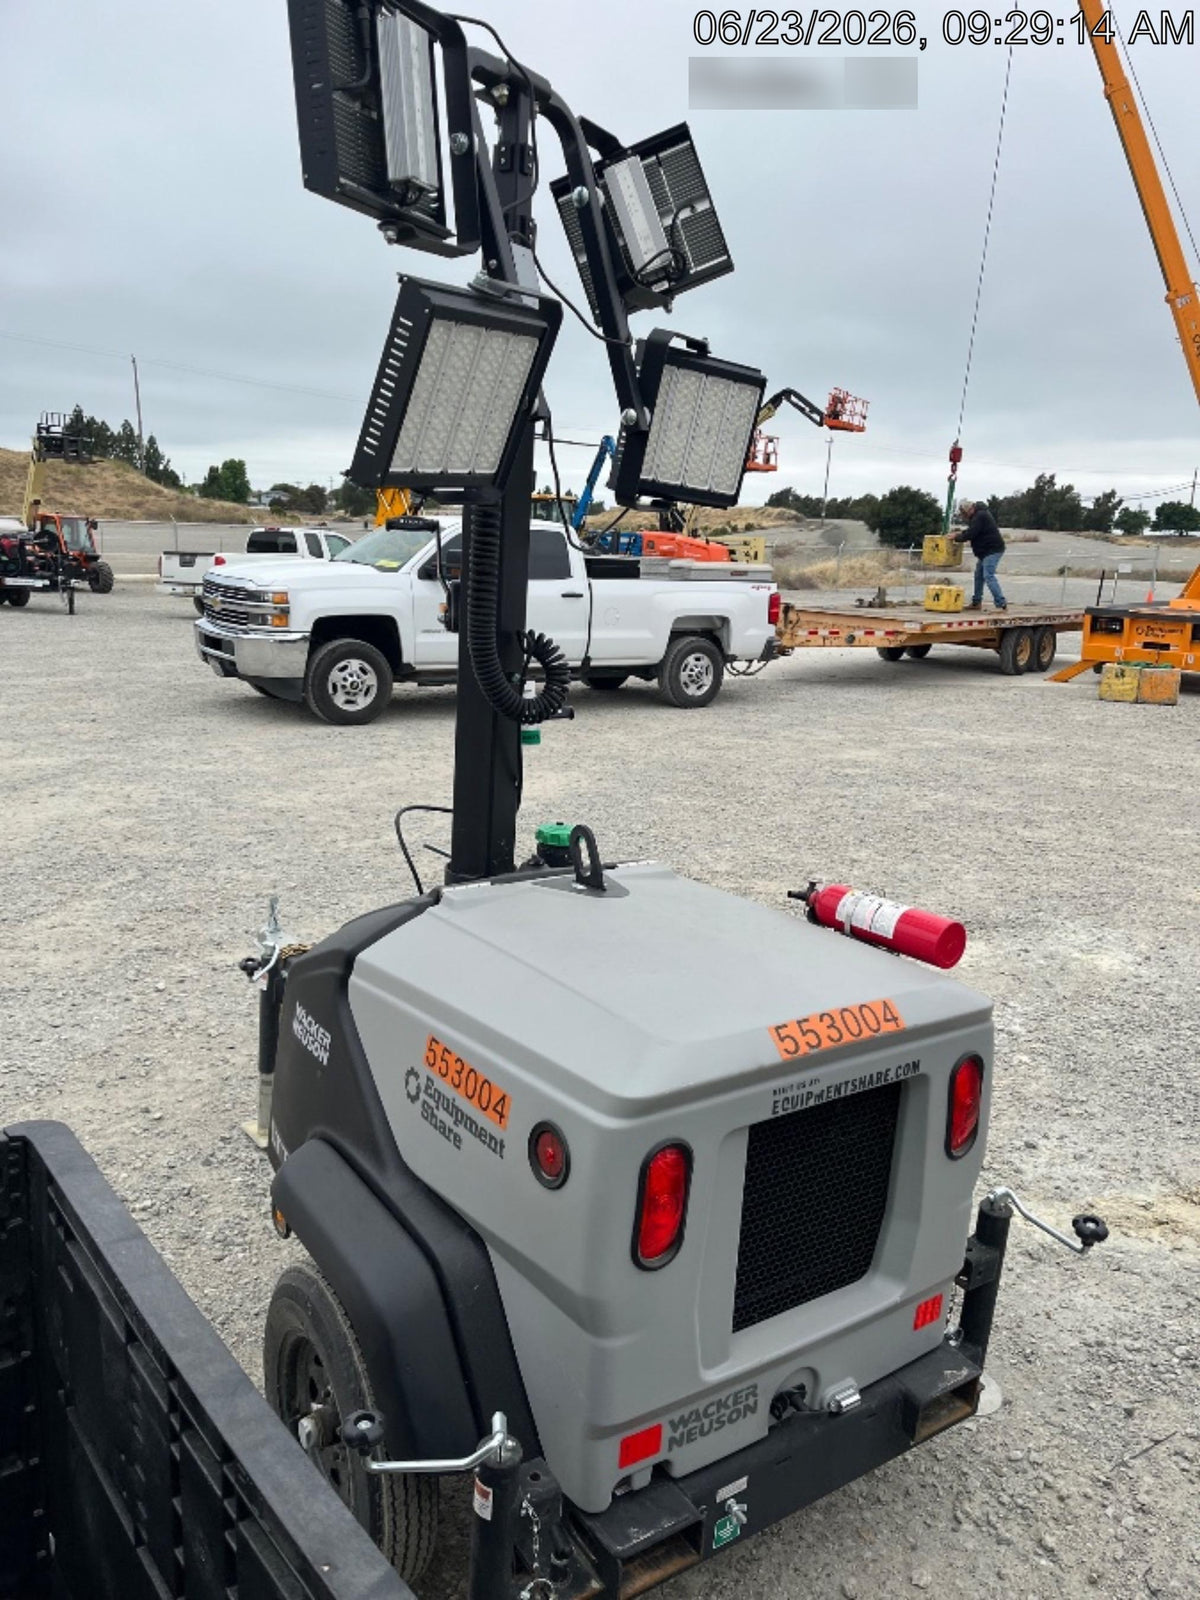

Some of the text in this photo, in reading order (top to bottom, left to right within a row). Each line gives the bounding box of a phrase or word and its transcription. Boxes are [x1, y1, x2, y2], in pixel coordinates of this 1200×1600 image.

[775, 1000, 900, 1056] 553004
[426, 1036, 508, 1125] 553004
[421, 1100, 463, 1150] Share
[423, 1075, 506, 1160] Equipment
[668, 1383, 758, 1434] WACKER
[668, 1399, 758, 1453] NEUSON
